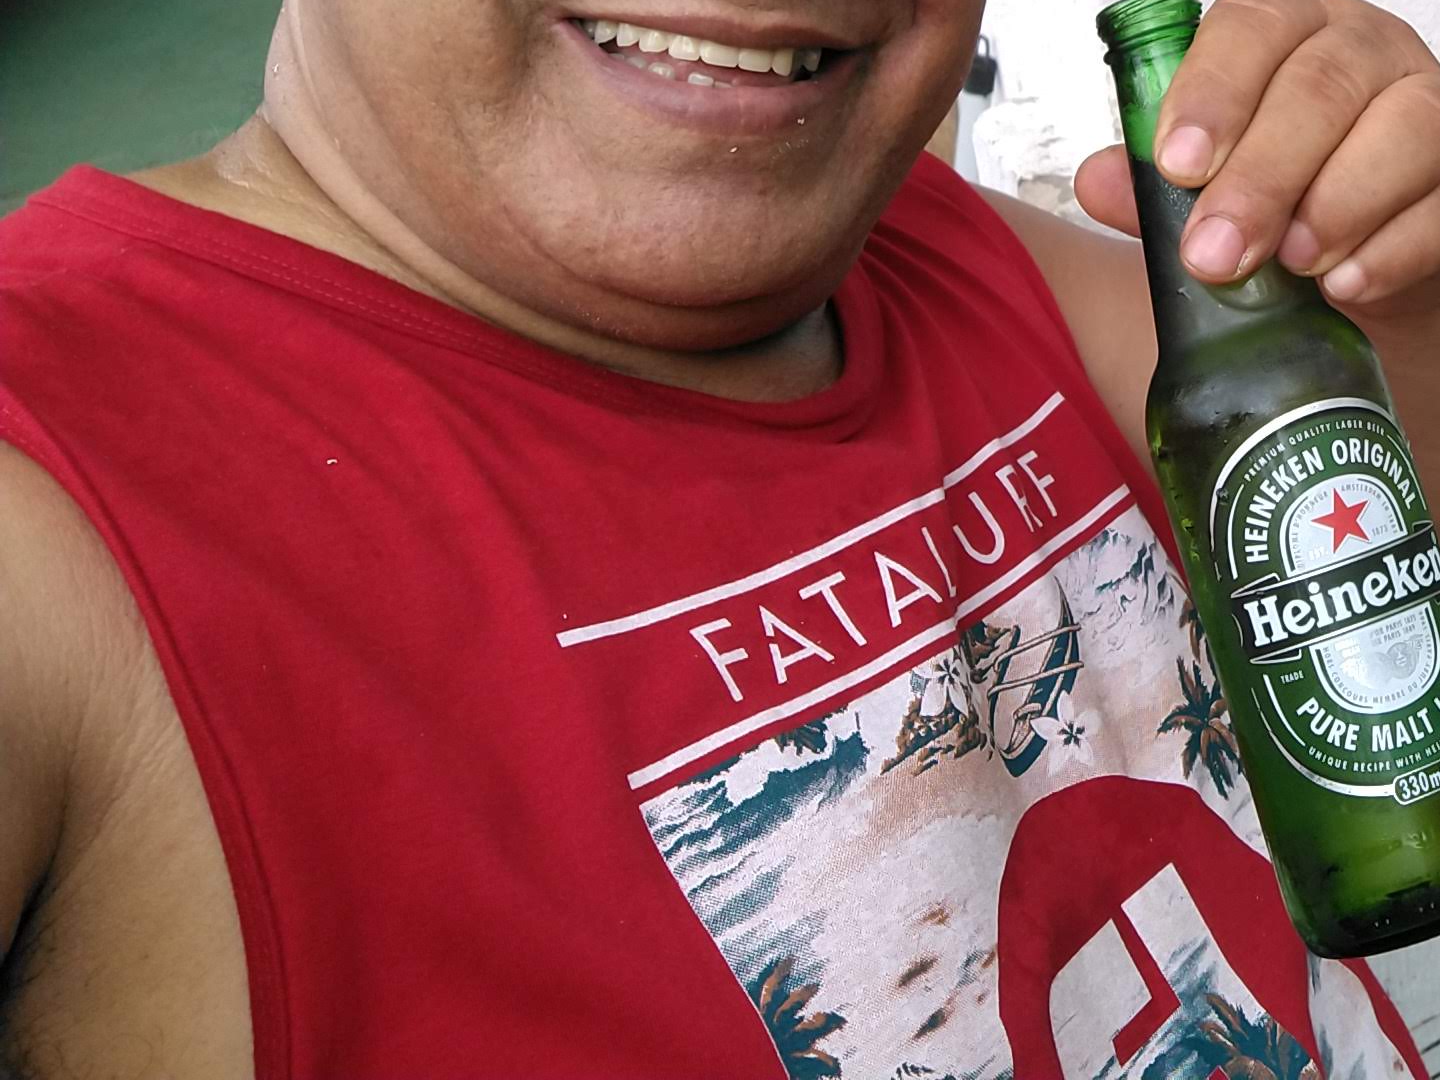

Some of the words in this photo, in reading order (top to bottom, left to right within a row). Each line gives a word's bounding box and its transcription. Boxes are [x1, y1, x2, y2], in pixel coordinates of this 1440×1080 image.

[1243, 443, 1286, 482] PREMIUM
[1288, 423, 1332, 446] QUALITY
[1335, 419, 1364, 430] LAGER
[1244, 446, 1325, 563] HEINEKEN
[1331, 438, 1417, 510] ORIGINAL
[1280, 670, 1304, 684] TRADE
[1296, 696, 1361, 751] PURE
[1371, 707, 1434, 753] MALT
[1308, 746, 1348, 770] UNIQUE
[1353, 762, 1391, 773] RECIPE
[1395, 752, 1422, 769] WITH
